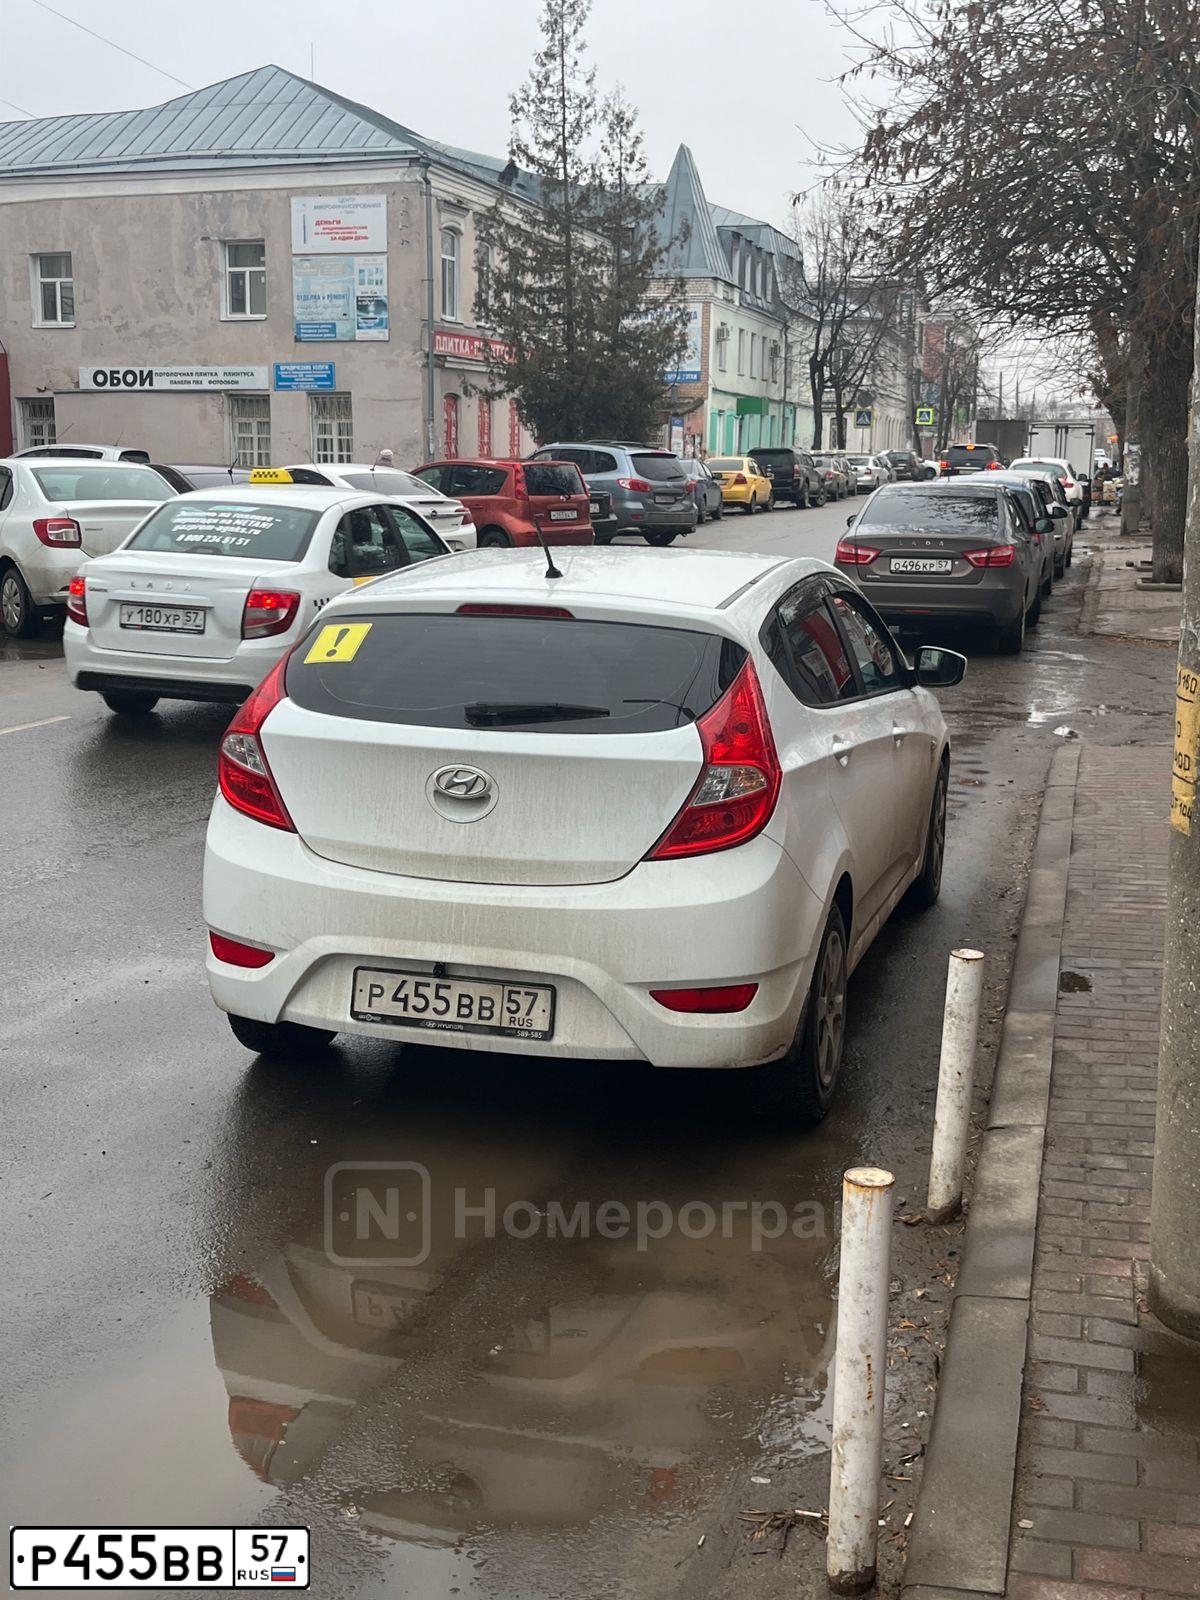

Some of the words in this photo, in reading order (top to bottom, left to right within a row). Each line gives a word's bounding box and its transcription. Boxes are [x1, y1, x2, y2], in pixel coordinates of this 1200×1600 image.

[435, 335, 470, 354] ПЛИТКА
[92, 369, 154, 388] ОБОИ
[938, 561, 948, 569] 57
[185, 611, 200, 623] 57
[367, 980, 496, 1021] Р455ВВ
[506, 990, 539, 1017] 57
[509, 1016, 534, 1028] RUS
